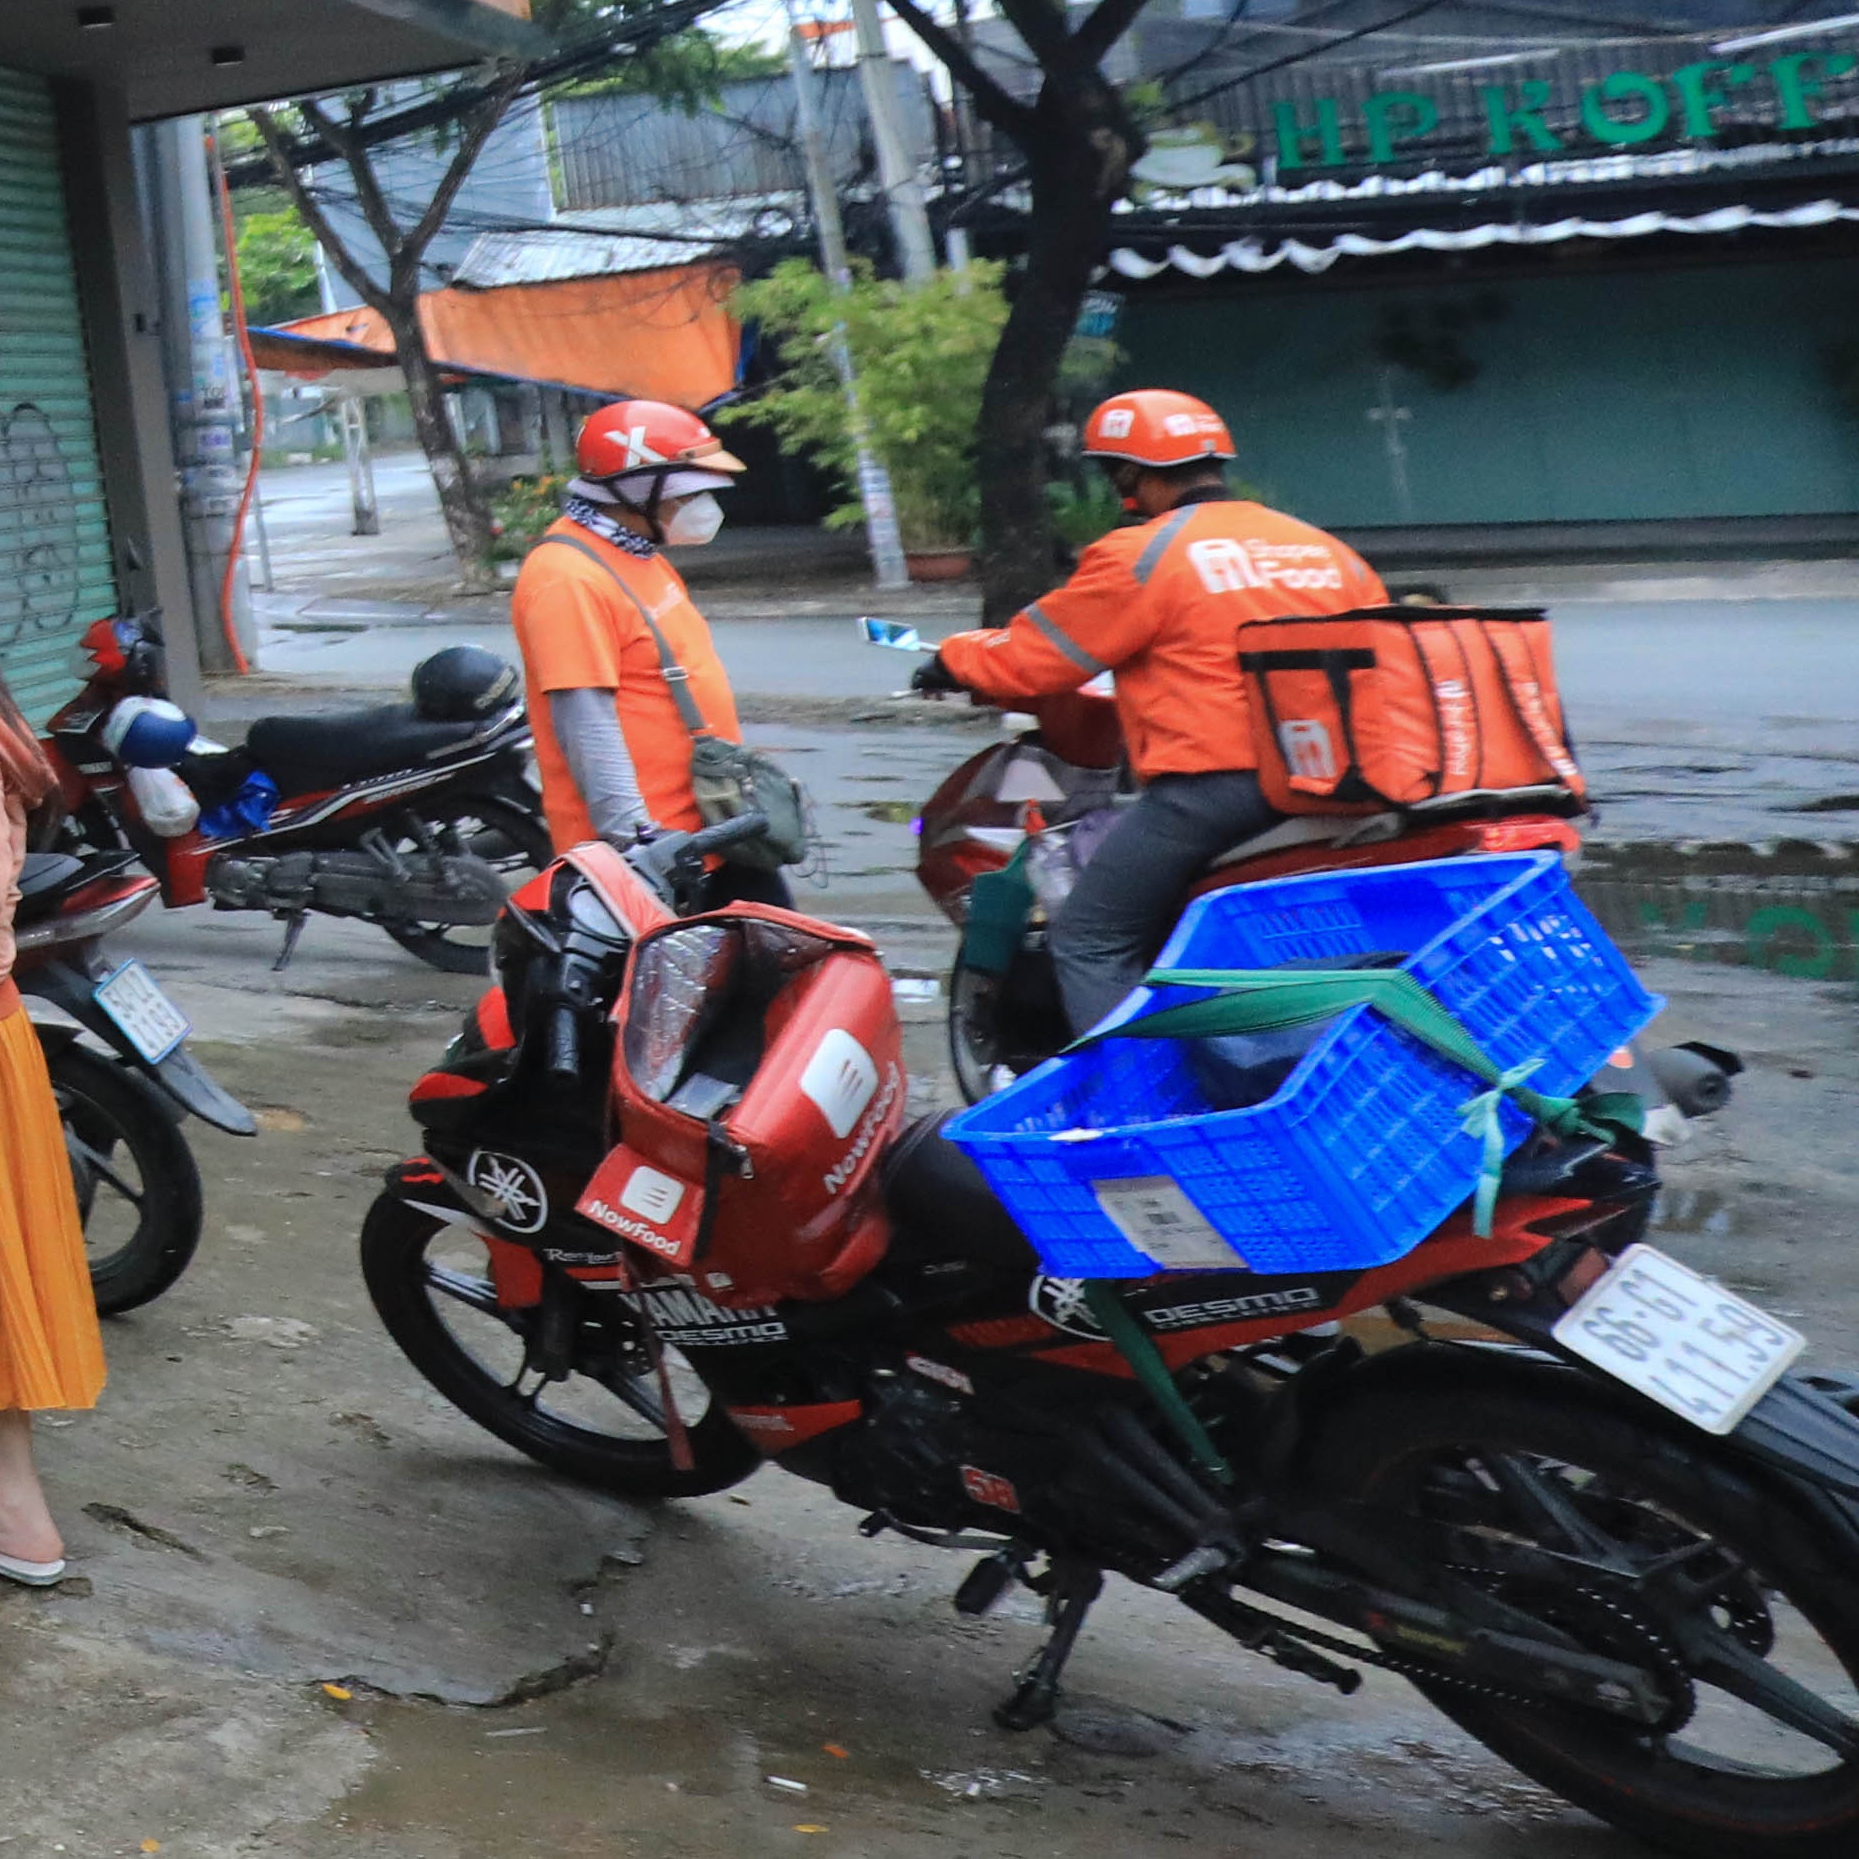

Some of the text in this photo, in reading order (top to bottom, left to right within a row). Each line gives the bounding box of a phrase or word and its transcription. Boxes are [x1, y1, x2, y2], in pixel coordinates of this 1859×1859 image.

[1271, 89, 1441, 170] HP
[1256, 560, 1343, 589] Food
[824, 1060, 902, 1195] NowFood
[588, 1199, 682, 1257] NowFood
